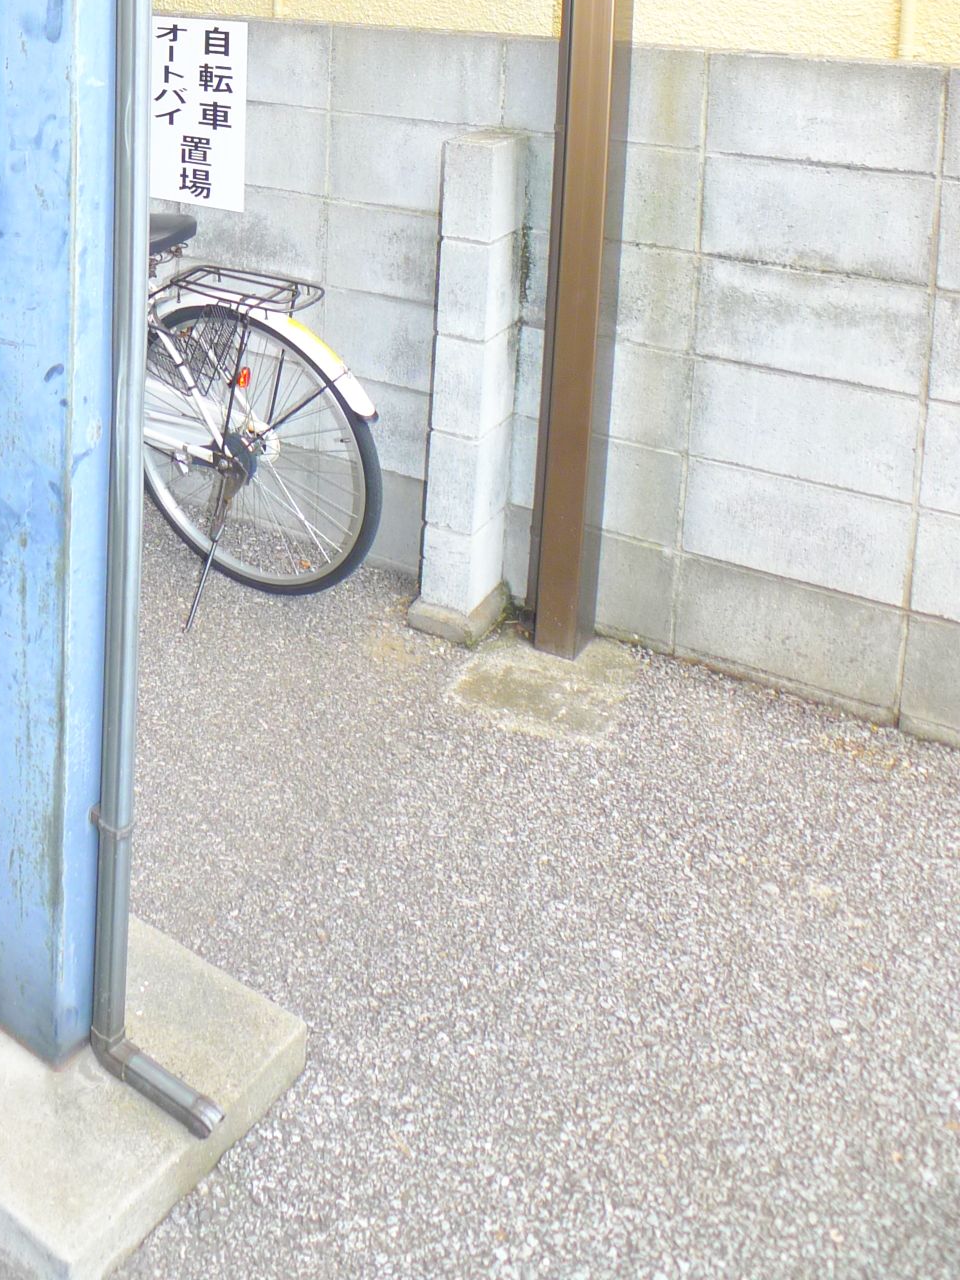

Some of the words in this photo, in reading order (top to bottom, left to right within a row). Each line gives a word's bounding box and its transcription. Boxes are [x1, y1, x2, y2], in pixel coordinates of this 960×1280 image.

[154, 23, 188, 126] オートバイ
[198, 26, 234, 131] 自転車
[178, 134, 213, 200] 置場
